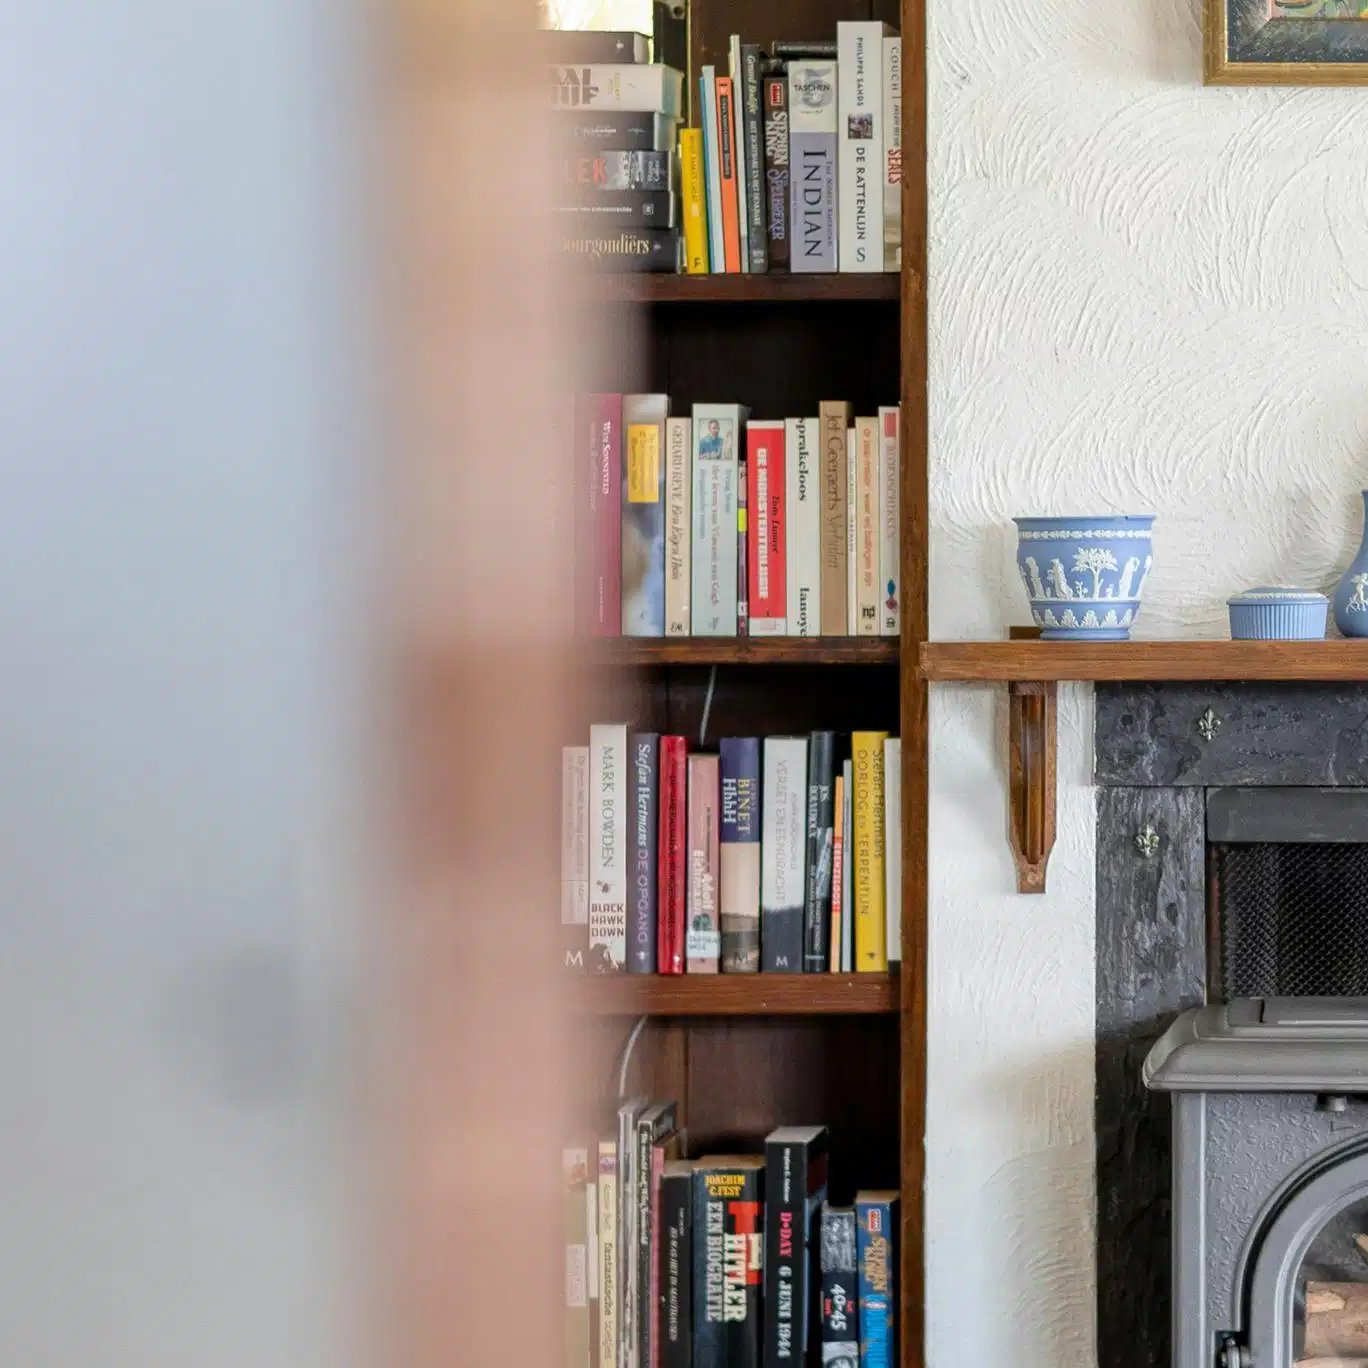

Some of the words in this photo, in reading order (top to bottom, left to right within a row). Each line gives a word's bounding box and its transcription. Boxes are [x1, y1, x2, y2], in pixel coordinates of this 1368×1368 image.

[856, 37, 864, 75] PHILIPPE
[891, 46, 901, 91] COUCH
[793, 82, 831, 92] TASCHEN
[766, 120, 779, 157] KING
[773, 111, 789, 165] STEPHEN
[855, 147, 866, 163] DE
[888, 148, 902, 185] SEALS
[855, 167, 867, 241] RATTENLIJN
[563, 232, 650, 261] ourgondiërs
[671, 425, 684, 469] GERARD
[796, 417, 809, 502] sprakeloos
[672, 471, 685, 500] REVE
[826, 436, 845, 511] Geeraerts
[794, 587, 811, 636] lanoye
[602, 746, 615, 792] MARK
[634, 744, 651, 783] Stefan
[857, 749, 869, 810] OORLOG
[872, 749, 885, 789] Stefan
[638, 786, 651, 846] Hertmans
[723, 778, 737, 824] HhhH
[737, 778, 750, 835] BINET
[602, 799, 616, 868] BOWDEN
[873, 795, 885, 859] Hertmans
[637, 848, 649, 865] DE
[858, 833, 870, 916] TERPENTIJN
[692, 849, 704, 914] Eichmann
[702, 875, 714, 910] Adolf
[591, 903, 624, 913] BLACK
[591, 915, 624, 925] HAWK
[637, 875, 649, 944] OPGANG
[591, 927, 625, 937] DOWN
[705, 1175, 746, 1186] JOACHIM
[706, 1201, 723, 1233] EEN
[706, 1235, 723, 1322] BIOGRAFIE
[723, 1233, 747, 1322] HITLER
[778, 1265, 792, 1277] 6
[864, 1246, 876, 1282] KING
[871, 1235, 887, 1290] STEPHEN
[778, 1280, 792, 1317] JUNI
[829, 1283, 847, 1331] 40-45
[778, 1321, 792, 1358] 1944
